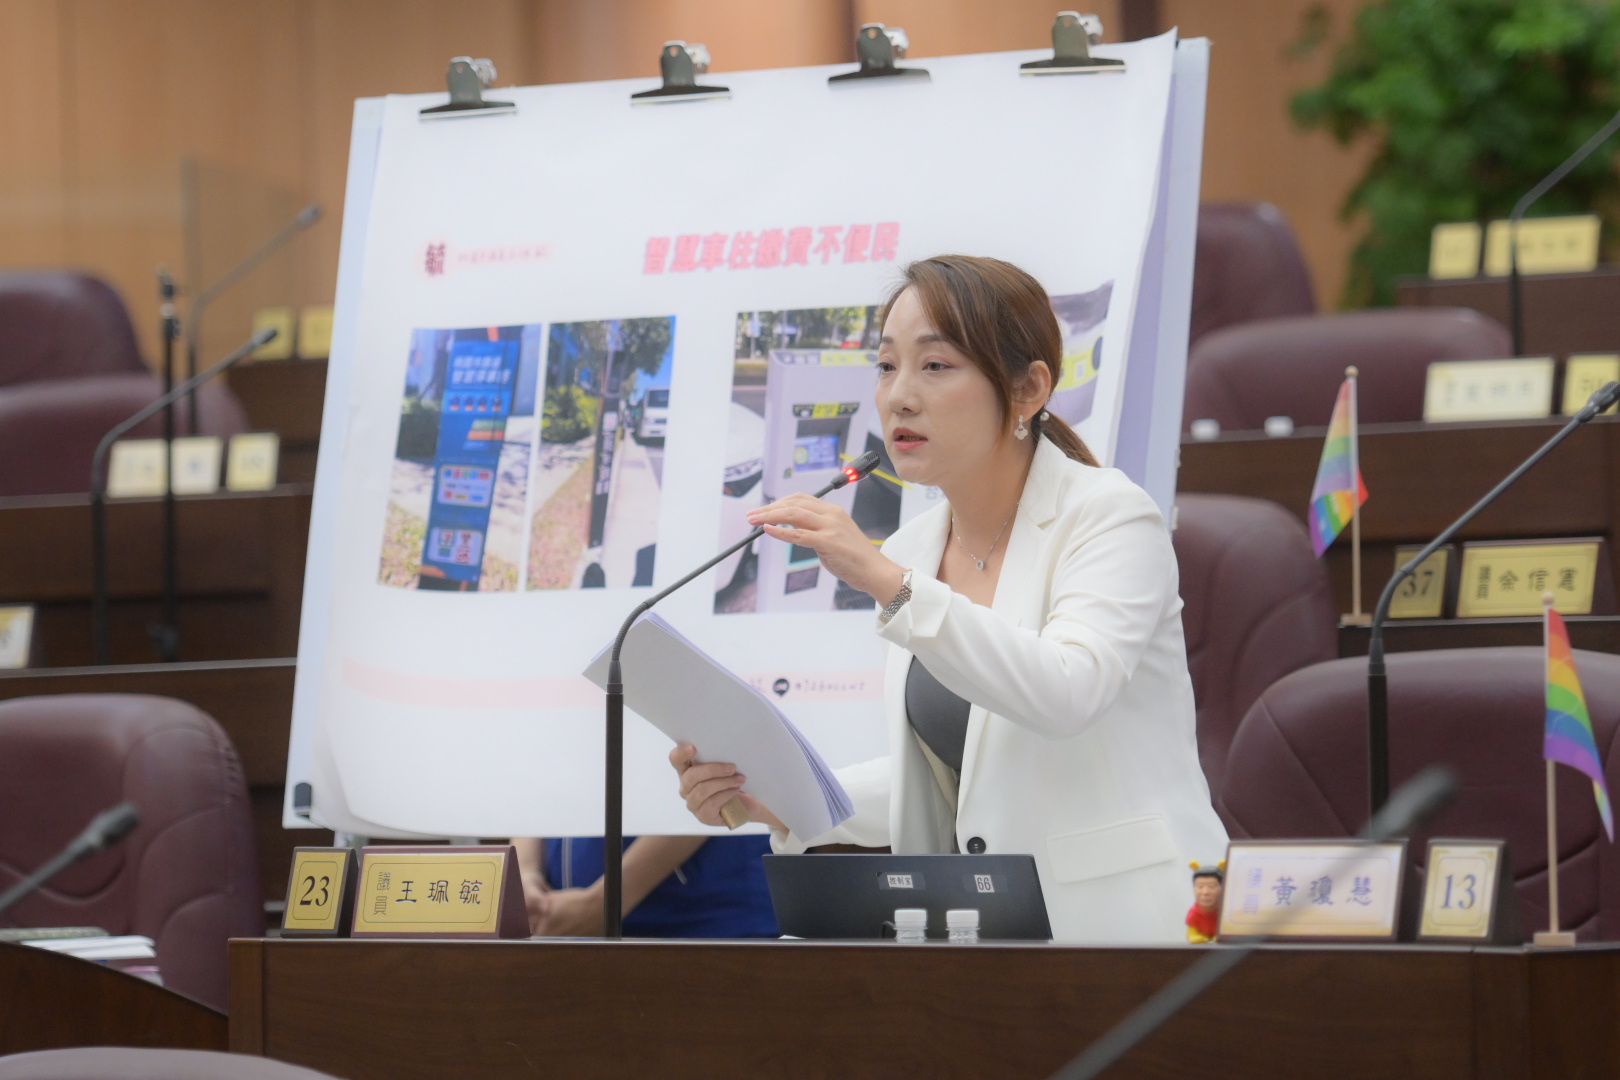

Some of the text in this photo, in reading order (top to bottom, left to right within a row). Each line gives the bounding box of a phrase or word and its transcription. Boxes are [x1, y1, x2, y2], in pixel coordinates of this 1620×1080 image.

[1402, 569, 1434, 599] 37
[1498, 567, 1578, 592] 余信憲
[299, 875, 331, 907] 23
[373, 871, 391, 915] 議員
[395, 879, 483, 905] 王珮毓
[976, 877, 992, 891] 66
[1243, 867, 1263, 915] 議員
[1271, 875, 1373, 906] 黃瓊慧
[1439, 873, 1478, 910] 13
